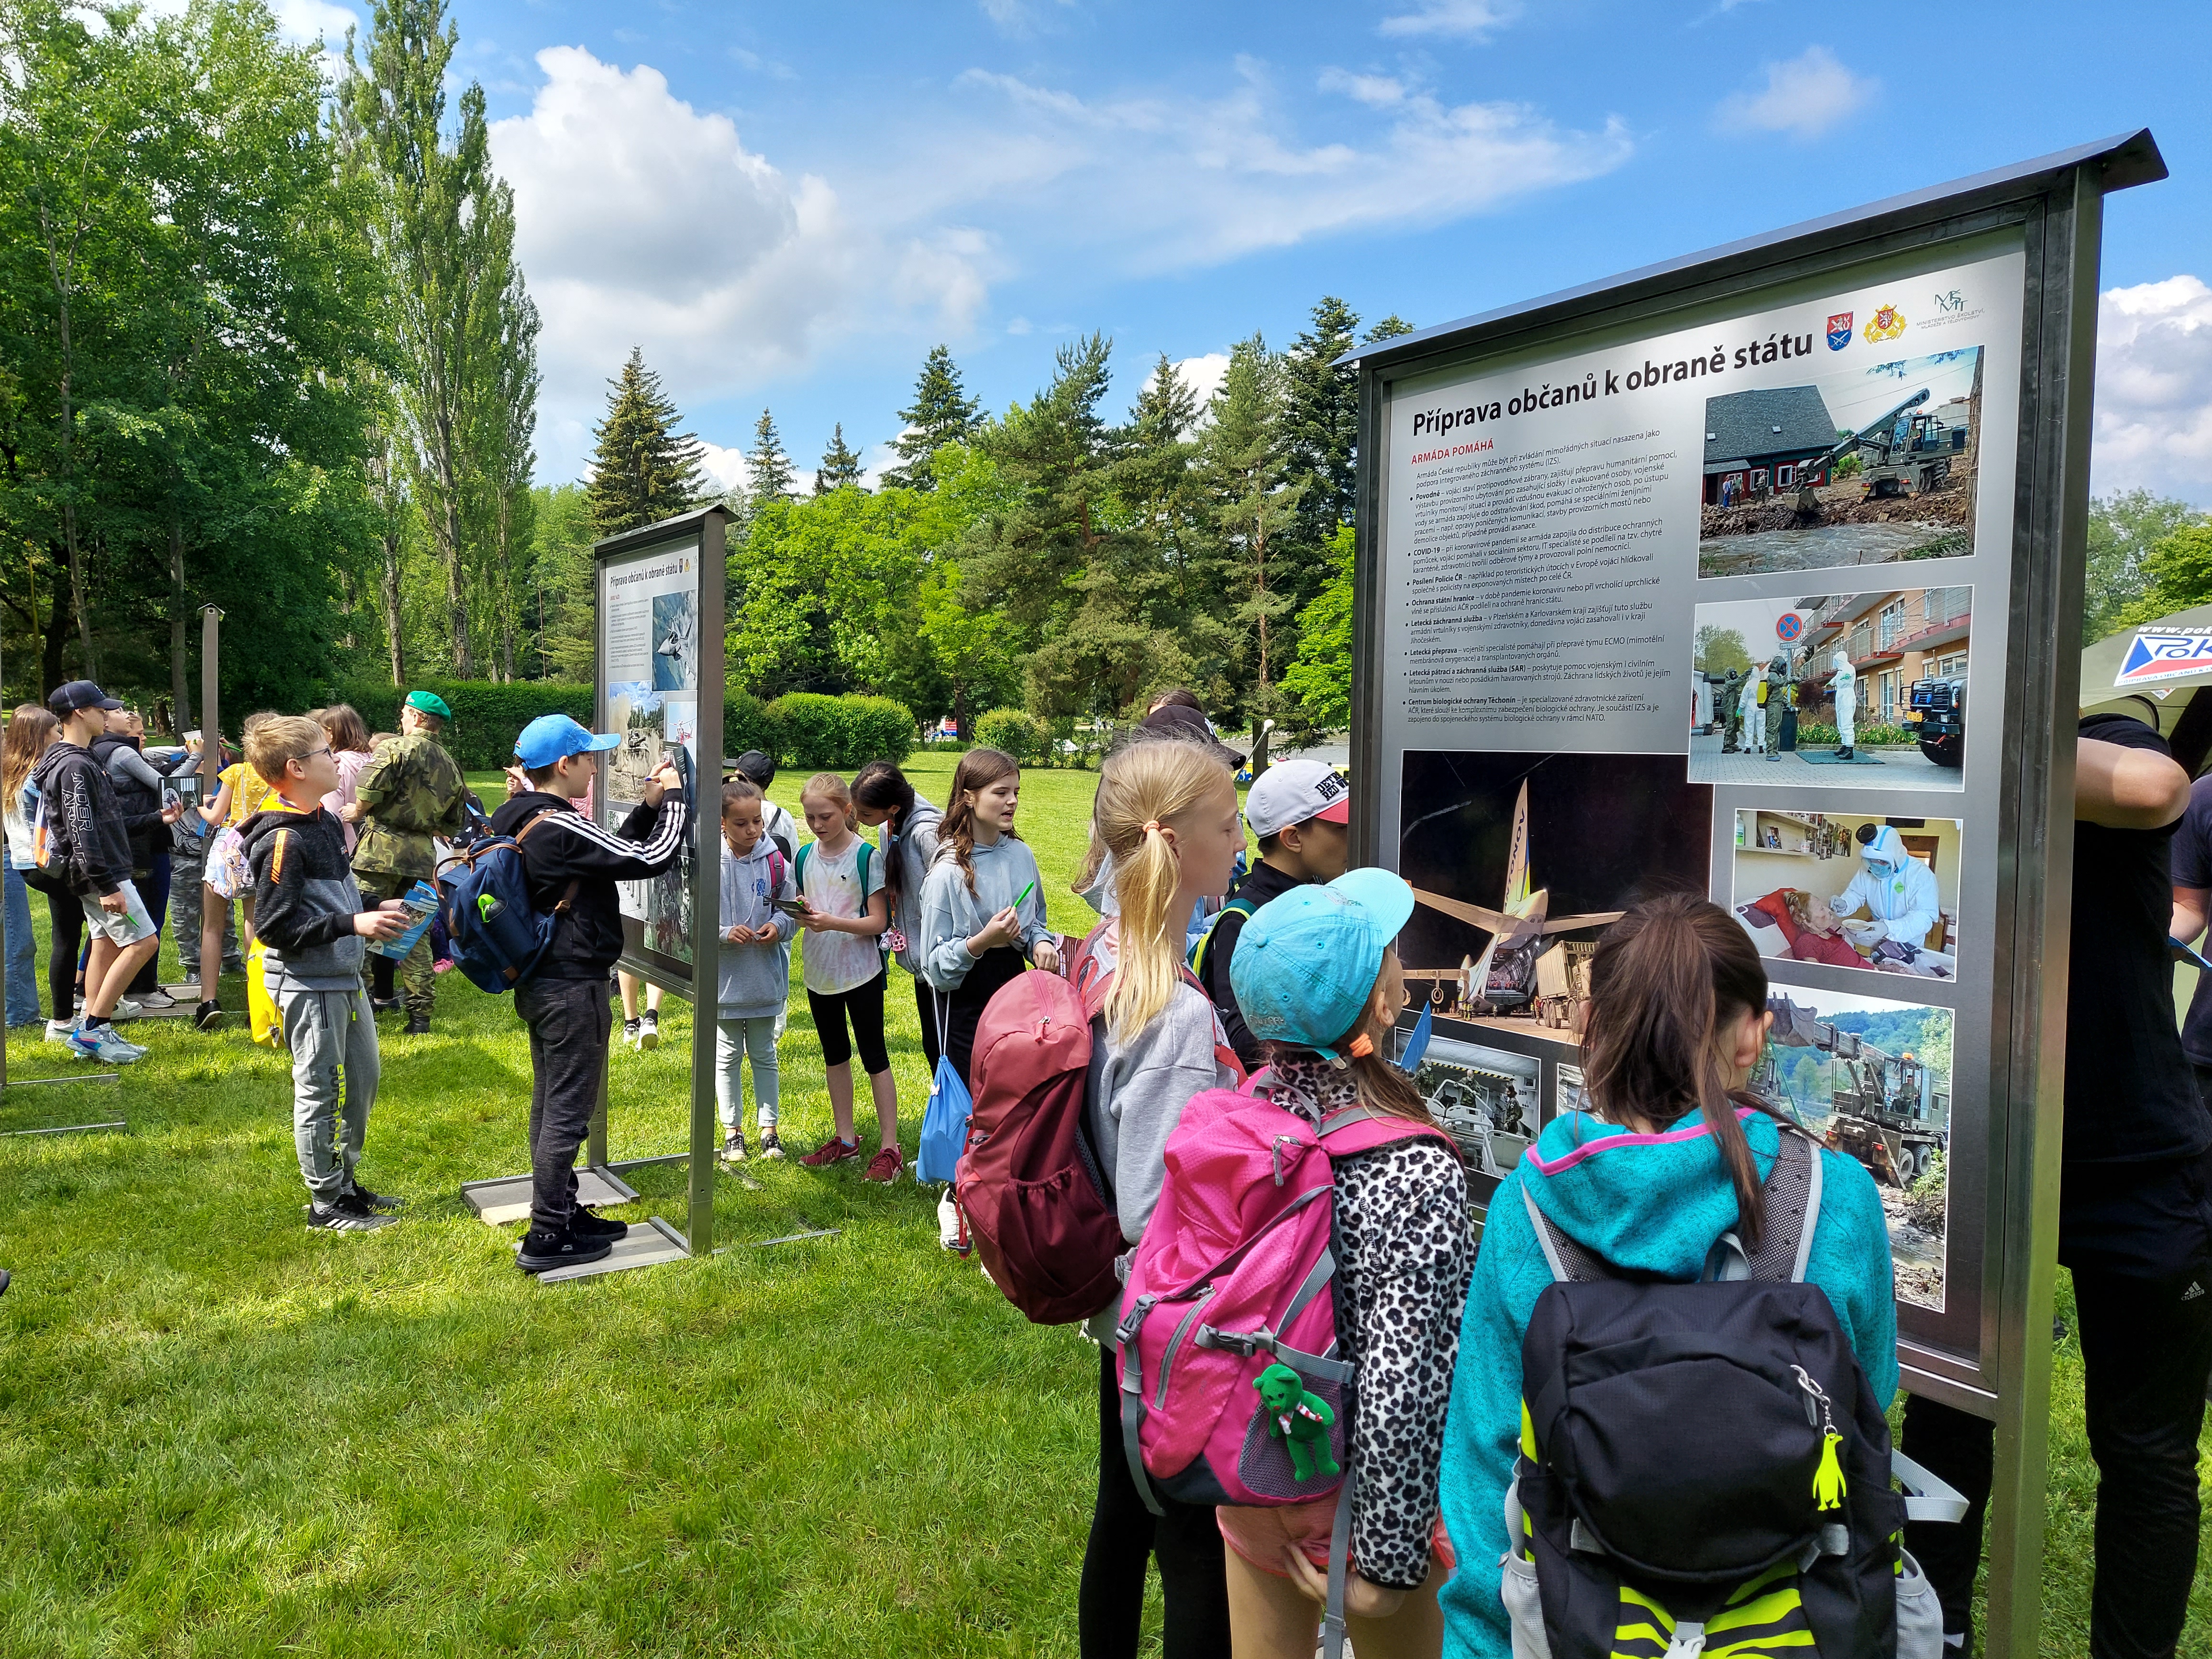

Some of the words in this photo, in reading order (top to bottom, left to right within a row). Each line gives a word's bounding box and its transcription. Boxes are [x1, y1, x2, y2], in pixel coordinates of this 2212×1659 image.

[1916, 314, 1956, 326] MINISTERSTVO
[1414, 402, 1501, 436] Příprava
[1508, 373, 1596, 415] občanů
[1604, 369, 1619, 396] k
[1626, 344, 1725, 390] obraně
[1734, 332, 1812, 369] státu
[1411, 448, 1449, 465] ARMÁDA
[1452, 437, 1493, 456] POMÁHÁ
[1416, 469, 1437, 479] Armáda
[1438, 466, 1454, 475] České
[1455, 462, 1481, 473] republiky
[1482, 458, 1497, 467] může
[1499, 456, 1508, 465] být
[1509, 454, 1517, 464] při
[1518, 449, 1544, 461] zvládání
[1590, 436, 1612, 448] situací
[1613, 433, 1643, 443] nasazena
[1644, 429, 1659, 440] jako
[1415, 499, 1438, 509] výstavbu
[1505, 488, 1515, 497] pro
[1515, 481, 1546, 493] zasahující
[1547, 478, 1566, 488] složky
[1571, 471, 1609, 484] evakuované
[1611, 468, 1632, 477] osoby,
[1634, 462, 1664, 475] vojenské
[1416, 479, 1438, 489] podpora
[1481, 464, 1517, 476] záchranného
[1519, 461, 1544, 471] systému
[1545, 456, 1560, 466] (IZS).
[1416, 489, 1440, 500] Povodně
[1446, 486, 1461, 496] vojáci
[1462, 483, 1475, 492] staví
[1524, 473, 1549, 482] zábrany,
[1575, 464, 1604, 476] přepravu
[1606, 454, 1648, 468] humanitární
[1468, 500, 1486, 509] situaci
[1492, 496, 1515, 508] provádí
[1614, 478, 1632, 487] osob,
[1644, 473, 1668, 482] ústupu
[1415, 519, 1427, 527] vody
[1435, 514, 1455, 523] armáda
[1456, 510, 1480, 521] zapojuje
[1529, 500, 1545, 509] škod,
[1547, 497, 1572, 509] pomáhá
[1582, 489, 1619, 503] speciálními
[1414, 546, 1440, 556] COVID-19
[1588, 524, 1621, 534] distribuce
[1622, 517, 1662, 530] ochranných
[1438, 531, 1460, 542] objektů,
[1461, 528, 1487, 539] případně
[1456, 550, 1482, 561] pomáhali
[1548, 537, 1581, 550] specialisté
[1591, 533, 1615, 545] podíleli
[1640, 528, 1662, 539] chytré
[1489, 554, 1516, 564] odběrové
[1518, 554, 1533, 563] týmy
[1539, 548, 1575, 561] provozovali
[1577, 545, 1593, 557] polní
[610, 575, 627, 588] Příprava
[628, 568, 644, 584] občanů
[645, 568, 648, 580] k
[648, 564, 664, 579] obraně
[665, 562, 677, 575] státu
[1412, 576, 1434, 585] Posílení
[1435, 575, 1453, 583] Policie
[1468, 570, 1494, 580] například
[1546, 562, 1569, 571] útocích
[1576, 559, 1598, 568] Evropě
[1439, 583, 1462, 593] policisty
[1514, 575, 1537, 584] místech
[1548, 572, 1561, 580] celé
[1562, 571, 1573, 579] ČR.
[1435, 596, 1452, 604] státní
[1453, 594, 1474, 602] hranice
[1485, 591, 1500, 599] době
[1501, 588, 1531, 599] pandemie
[1532, 586, 1566, 595] koronaviru
[1567, 584, 1583, 592] nebo
[1624, 576, 1659, 588] uprchlické
[1457, 602, 1469, 610] AČR
[1500, 598, 1524, 607] ochraně
[1526, 597, 1545, 605] hranic
[1545, 595, 1562, 603] státu.
[1410, 627, 1432, 635] armádní
[1461, 623, 1493, 633] vojenskými
[1586, 613, 1620, 623] zasahovali
[1411, 618, 1432, 626] Letecká
[1433, 616, 1462, 625] záchranná
[1463, 614, 1482, 622] služba
[1493, 611, 1524, 620] Plzeňském
[1530, 608, 1571, 617] Karlovarském
[1573, 606, 1586, 615] kraji
[1630, 601, 1652, 610] službu
[1432, 647, 1457, 656] přeprava
[1463, 644, 1485, 654] vojenští
[1516, 641, 1545, 651] pomáhají
[1556, 639, 1584, 649] přepravě
[1586, 638, 1603, 648] týmu
[1604, 637, 1625, 645] ECMO
[1431, 667, 1451, 677] pátrací
[1488, 665, 1507, 673] služba
[1509, 664, 1526, 673] (SAR)
[1563, 664, 1586, 672] pomoc
[1587, 660, 1622, 670] vojenským
[1470, 675, 1499, 684] posádkám
[1652, 668, 1670, 678] jejím
[1433, 697, 1462, 706] biologické
[1463, 697, 1487, 705] ochrany
[1617, 693, 1644, 701] zařízení
[1322, 785, 1339, 801] RED
[1504, 807, 1525, 914] ANTONOV
